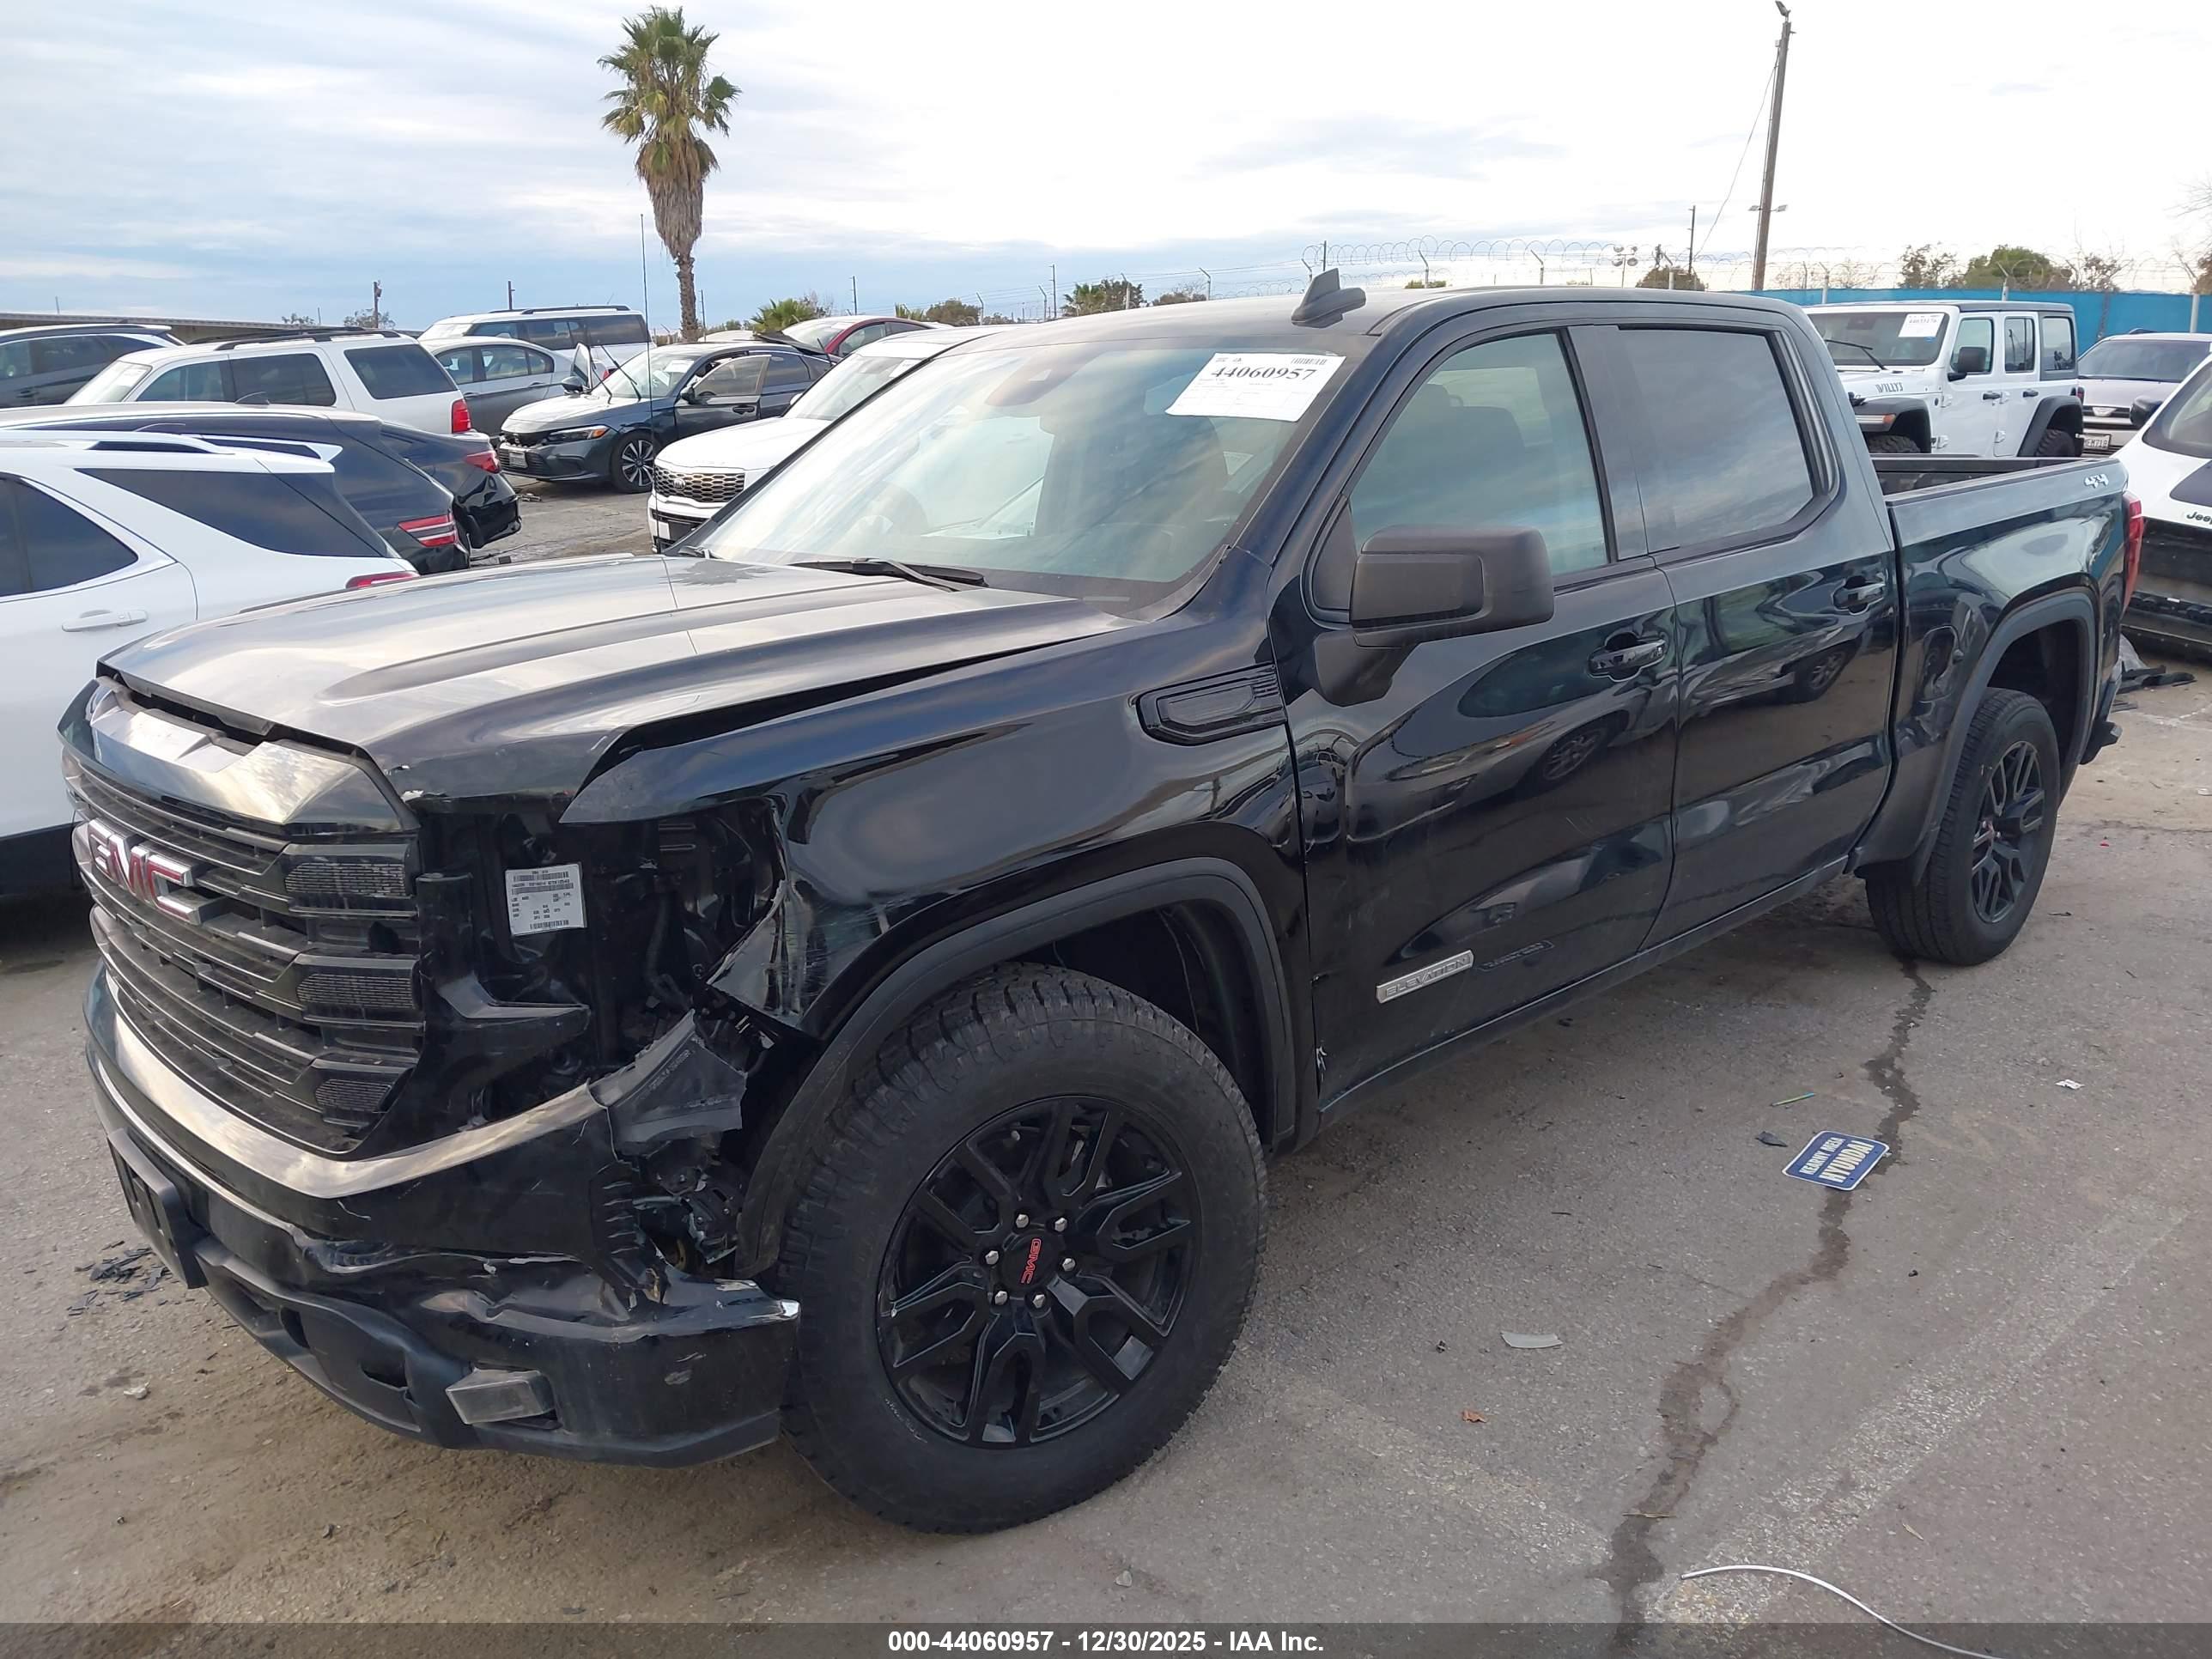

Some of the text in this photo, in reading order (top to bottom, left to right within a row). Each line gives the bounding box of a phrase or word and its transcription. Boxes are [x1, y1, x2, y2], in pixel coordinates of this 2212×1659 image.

[1211, 366, 1316, 380] 44060957
[1875, 382, 1903, 393] WILLYS
[87, 818, 201, 925] GMC
[1386, 959, 1465, 996] ELEVATION
[1799, 1151, 1831, 1175] KEARNY
[1819, 1140, 1875, 1183] HYUNDAI
[1021, 1238, 1042, 1285] GMC
